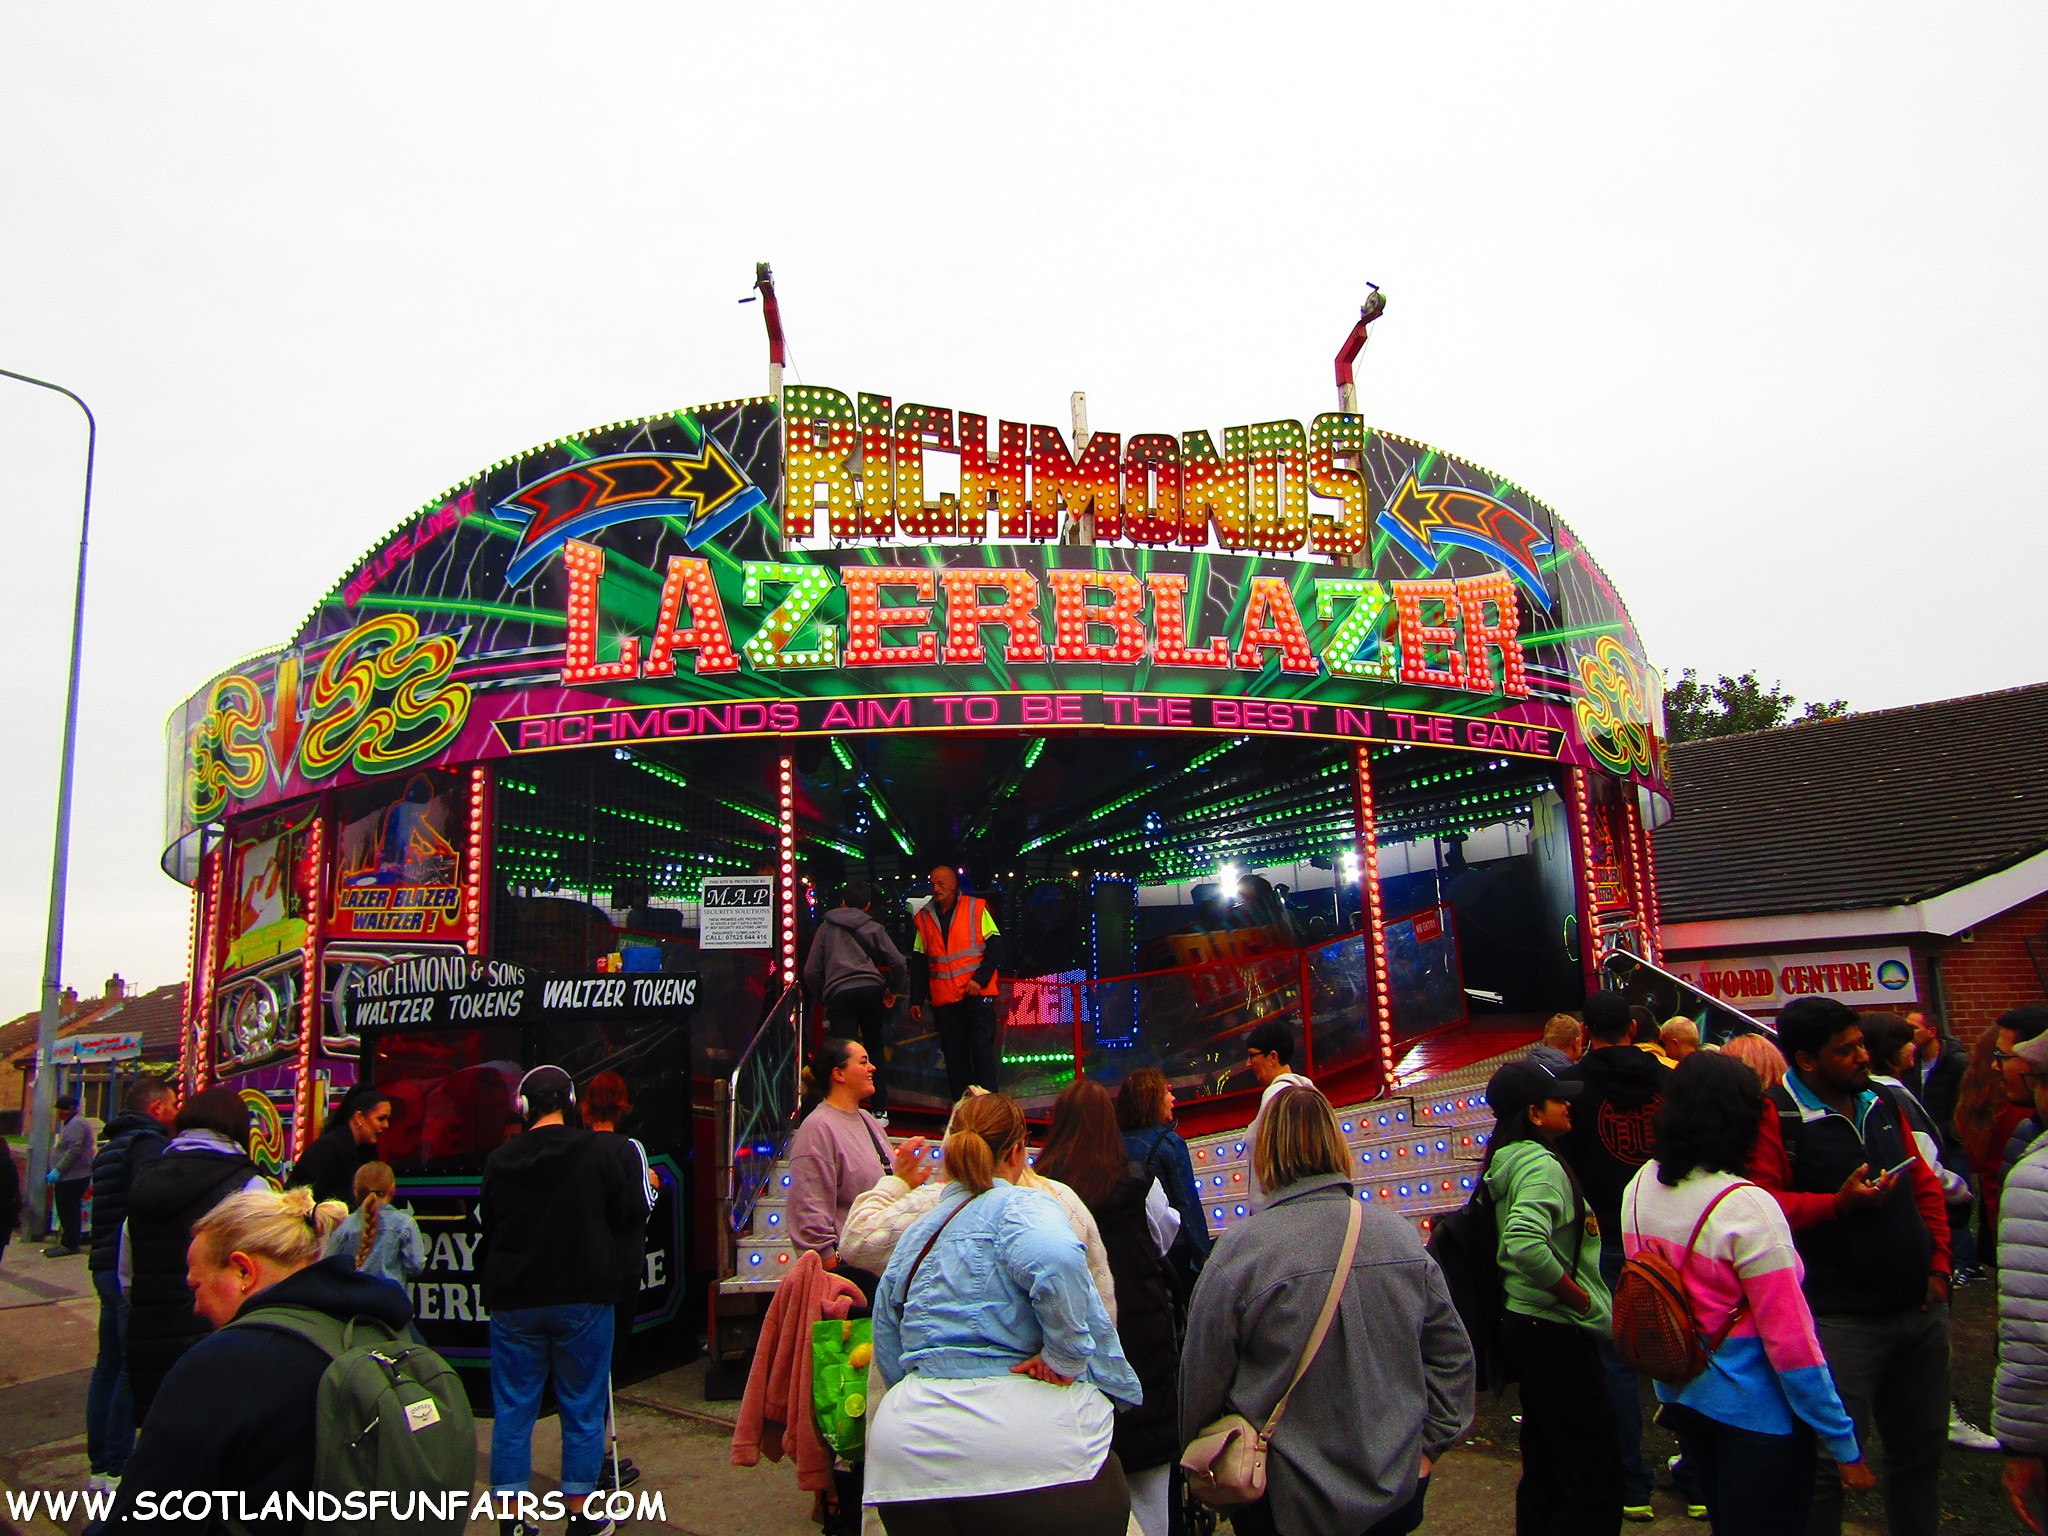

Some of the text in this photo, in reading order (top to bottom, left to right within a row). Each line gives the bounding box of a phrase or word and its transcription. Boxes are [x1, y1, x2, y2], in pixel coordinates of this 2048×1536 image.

[783, 385, 1367, 555] RICHMONDS
[561, 535, 1531, 700] LAZERBLAZER
[518, 695, 1551, 754] RICHMONDS AIM TO BE THE BEST IN THE GAME
[339, 887, 461, 909] LAZER BLAZER
[706, 886, 768, 906] M.A.P
[352, 911, 426, 933] WALTZER
[368, 956, 466, 997] RICHMOND
[471, 960, 484, 982] &
[488, 960, 526, 988] SONS
[543, 978, 697, 1009] WALTZER TOKENS
[1701, 962, 1874, 999] WORD CENTRE
[356, 989, 525, 1027] WALTZER TOKENS
[1007, 968, 1090, 1026] ZER
